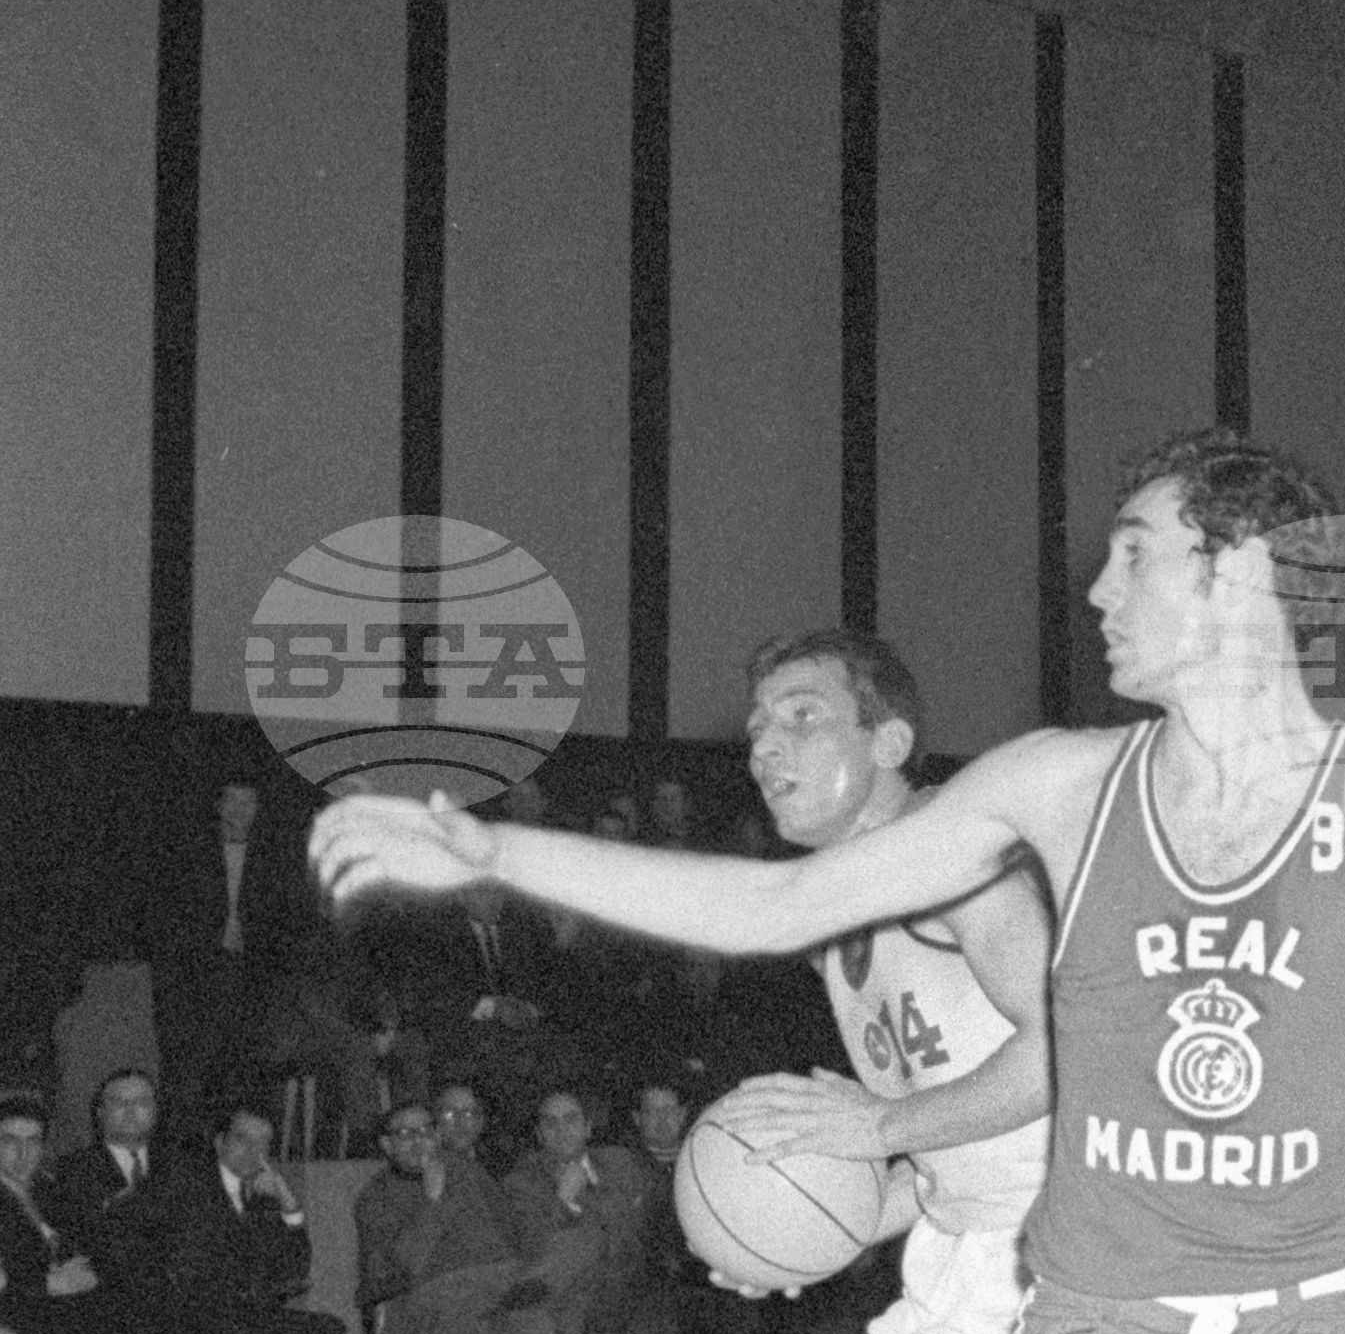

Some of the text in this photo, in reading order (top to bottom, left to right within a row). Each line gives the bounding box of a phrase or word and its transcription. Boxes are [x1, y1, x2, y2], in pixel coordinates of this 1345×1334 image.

[1311, 801, 1344, 872] 9
[1136, 917, 1306, 990] REAL
[876, 990, 951, 1081] 14
[1085, 1116, 1320, 1187] MADRID
